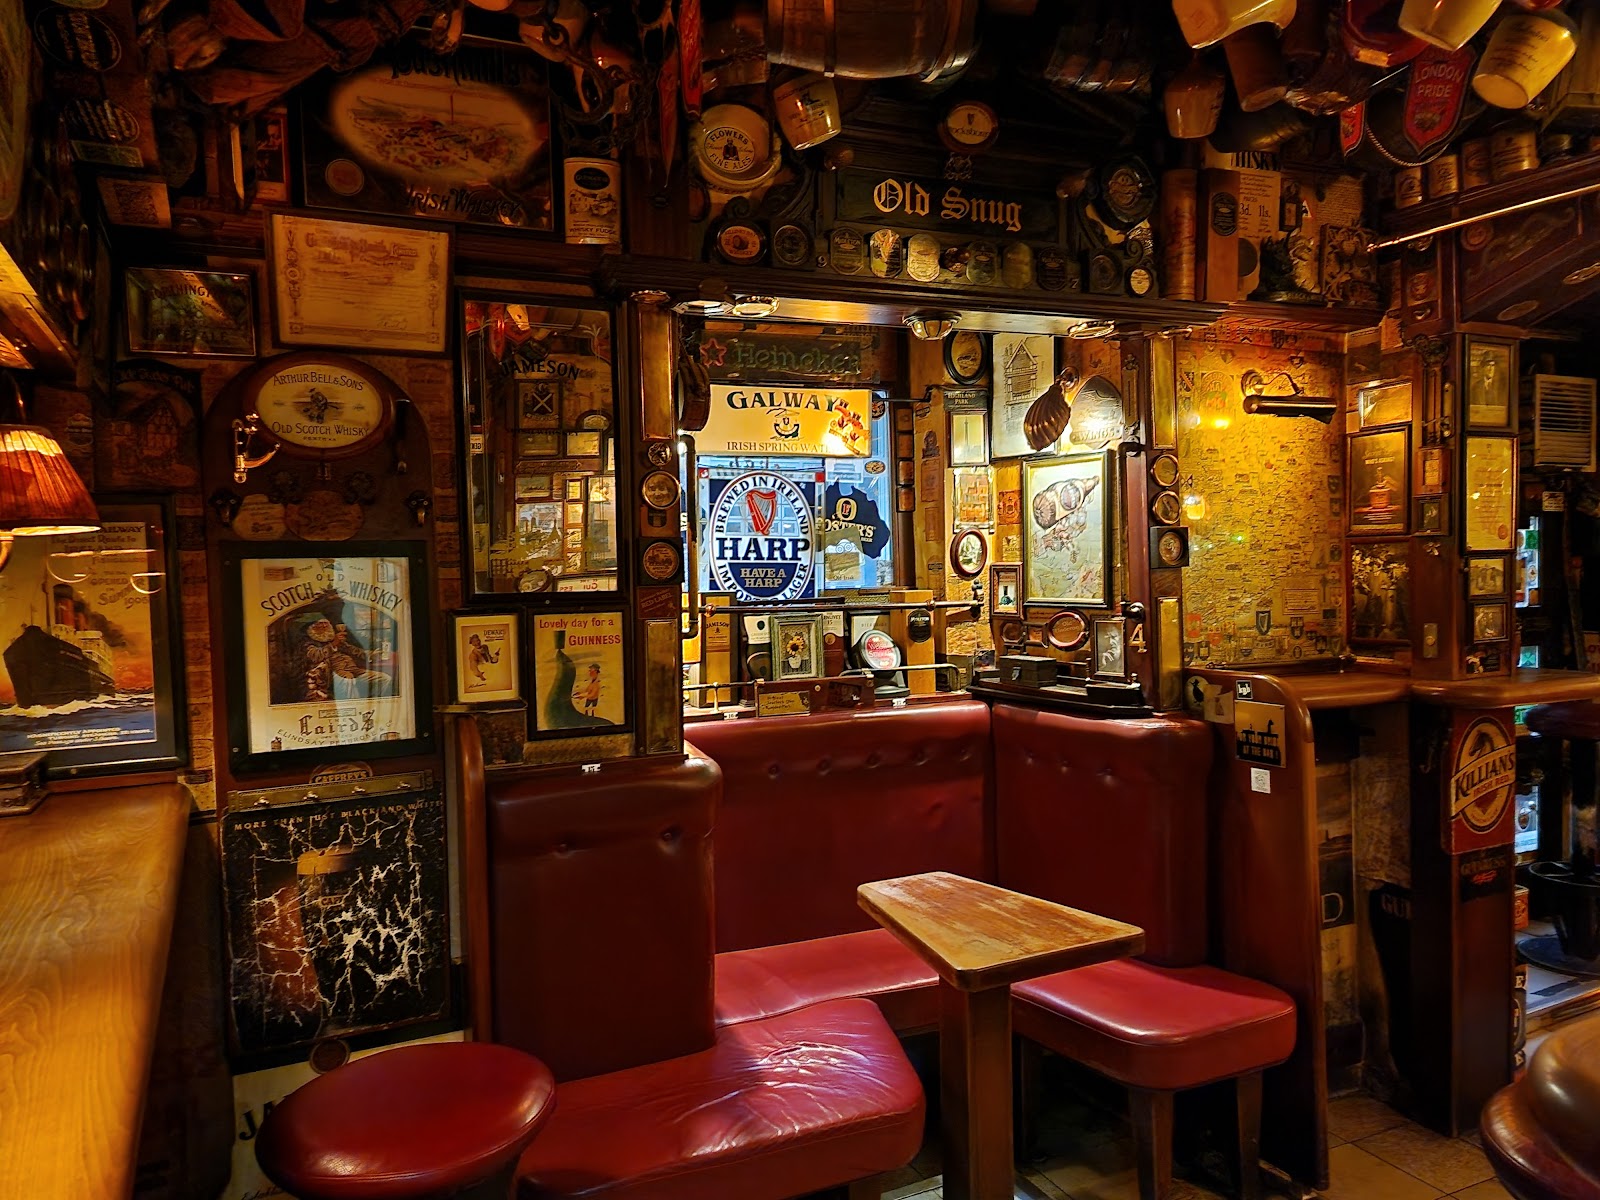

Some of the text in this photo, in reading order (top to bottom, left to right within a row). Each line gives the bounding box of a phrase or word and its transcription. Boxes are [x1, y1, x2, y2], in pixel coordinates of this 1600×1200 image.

[1415, 64, 1465, 84] LONDON
[1418, 84, 1453, 98] PRIDE
[709, 130, 748, 144] FLOWERS
[710, 153, 752, 169] FINE ALES
[873, 178, 1022, 233] Old Snug
[735, 342, 862, 374] Heineken
[501, 359, 580, 381] JAMESON
[273, 373, 310, 386] ARTHUR
[310, 371, 333, 384] BELL
[340, 375, 365, 391] SONS
[727, 391, 840, 412] GALWAY
[272, 421, 369, 437] OLD SCOTCH WHISKY
[727, 441, 757, 451] IRISH
[758, 441, 798, 452] SPRING
[715, 476, 809, 535] BREWED IN IRELAND
[715, 537, 811, 561] HARP
[316, 573, 344, 581] OLD
[739, 567, 787, 578] HAVE A
[744, 578, 783, 588] HARP
[261, 580, 403, 617] SCOTCH WHISKEY
[538, 618, 569, 630] Lovely
[571, 618, 588, 630] day
[592, 617, 606, 627] for
[705, 621, 730, 629] JAMESON
[568, 634, 622, 646] GUINNESS
[1128, 623, 1148, 653] 4
[1455, 751, 1515, 797] KILLIAN'S
[234, 820, 268, 830] MORE
[340, 807, 376, 819] BLACK
